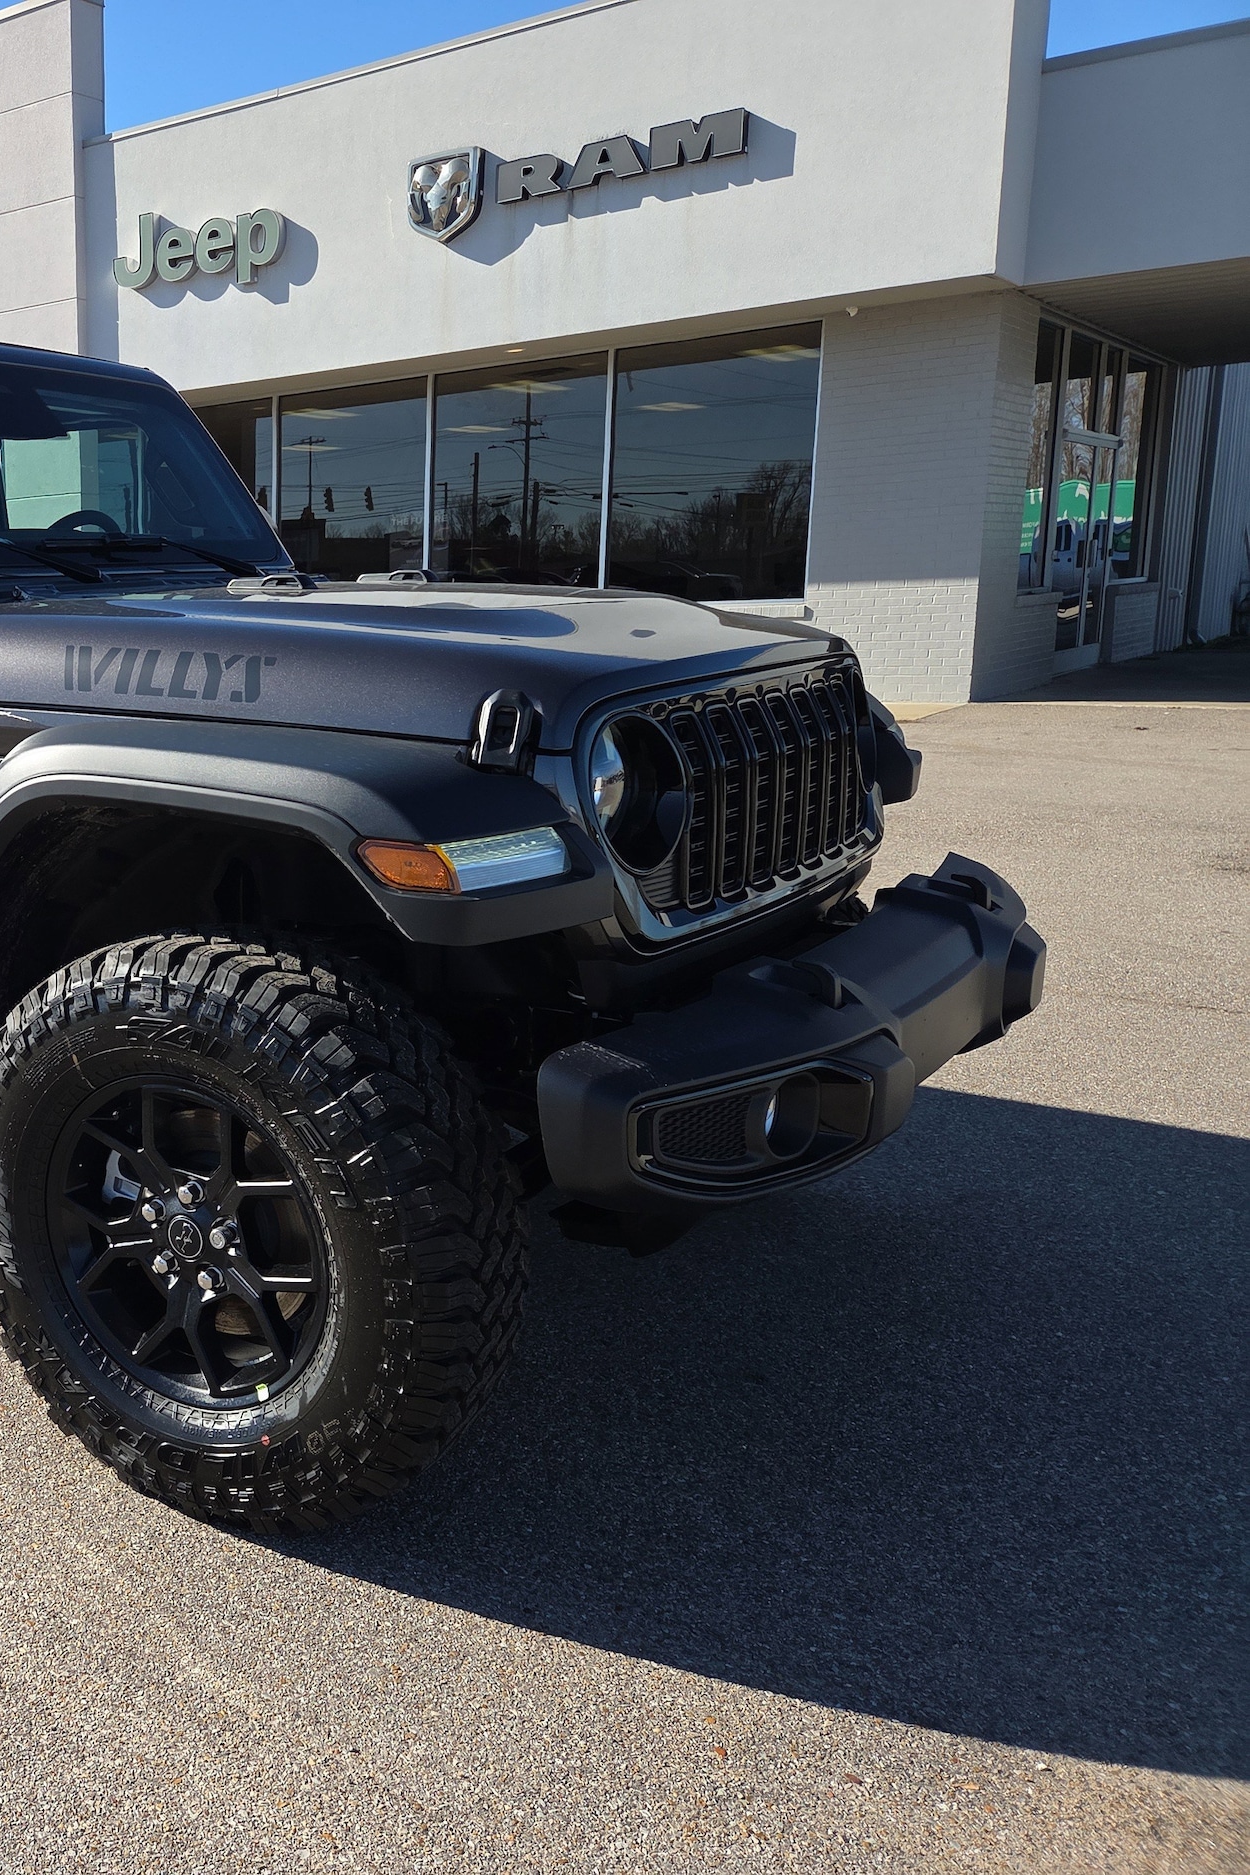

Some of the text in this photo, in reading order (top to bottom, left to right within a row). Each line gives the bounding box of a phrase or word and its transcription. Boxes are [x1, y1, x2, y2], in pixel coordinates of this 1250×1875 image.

[497, 107, 749, 204] RAM
[112, 207, 287, 290] Jeep
[64, 645, 278, 703] WILLYS
